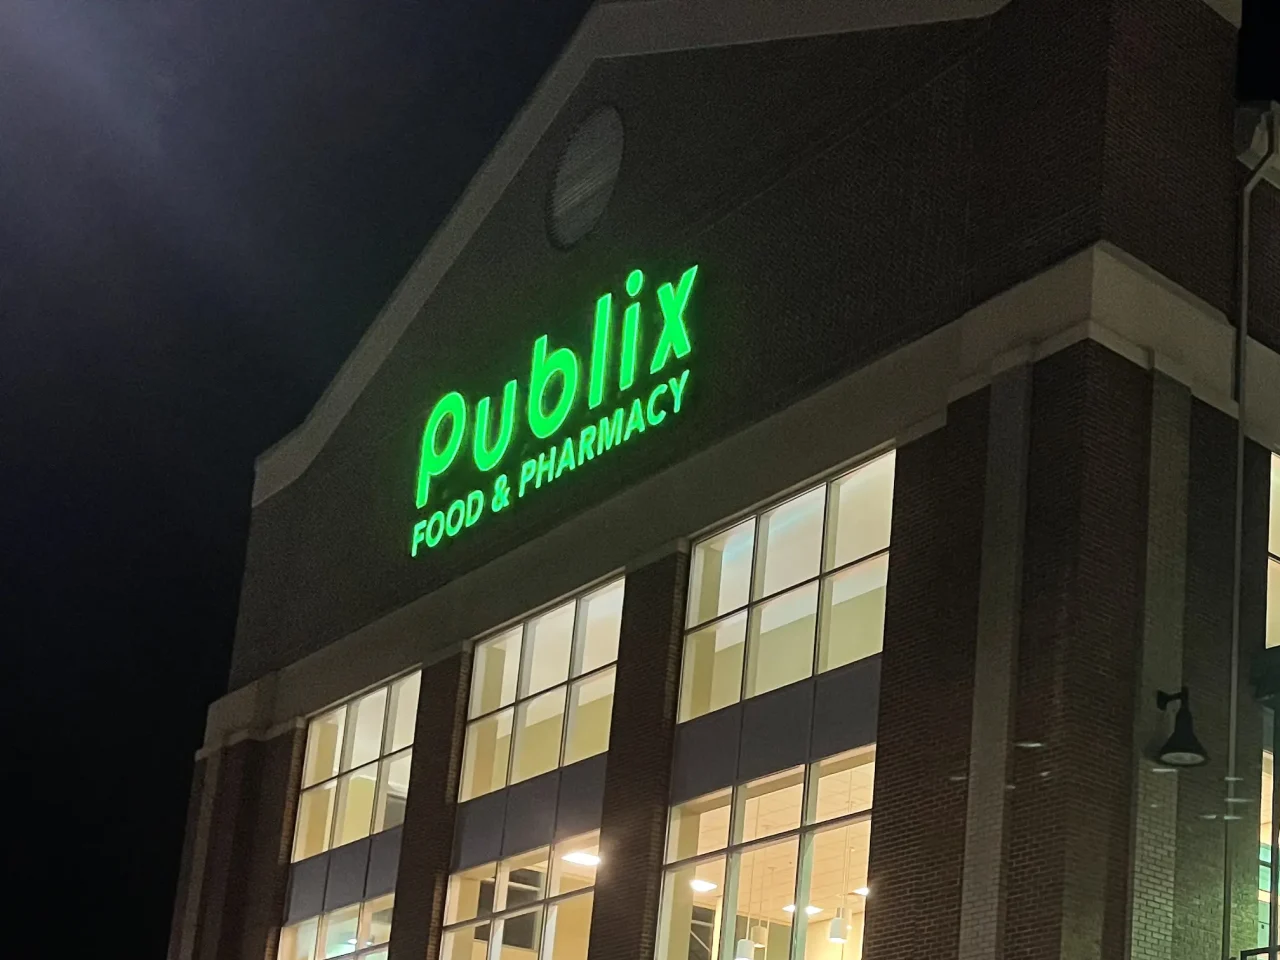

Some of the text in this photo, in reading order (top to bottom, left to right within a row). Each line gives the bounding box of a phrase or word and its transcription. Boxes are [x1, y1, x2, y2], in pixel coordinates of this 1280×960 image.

[411, 369, 690, 557] FOOD & PHARMACY
[416, 265, 698, 509] Publix
